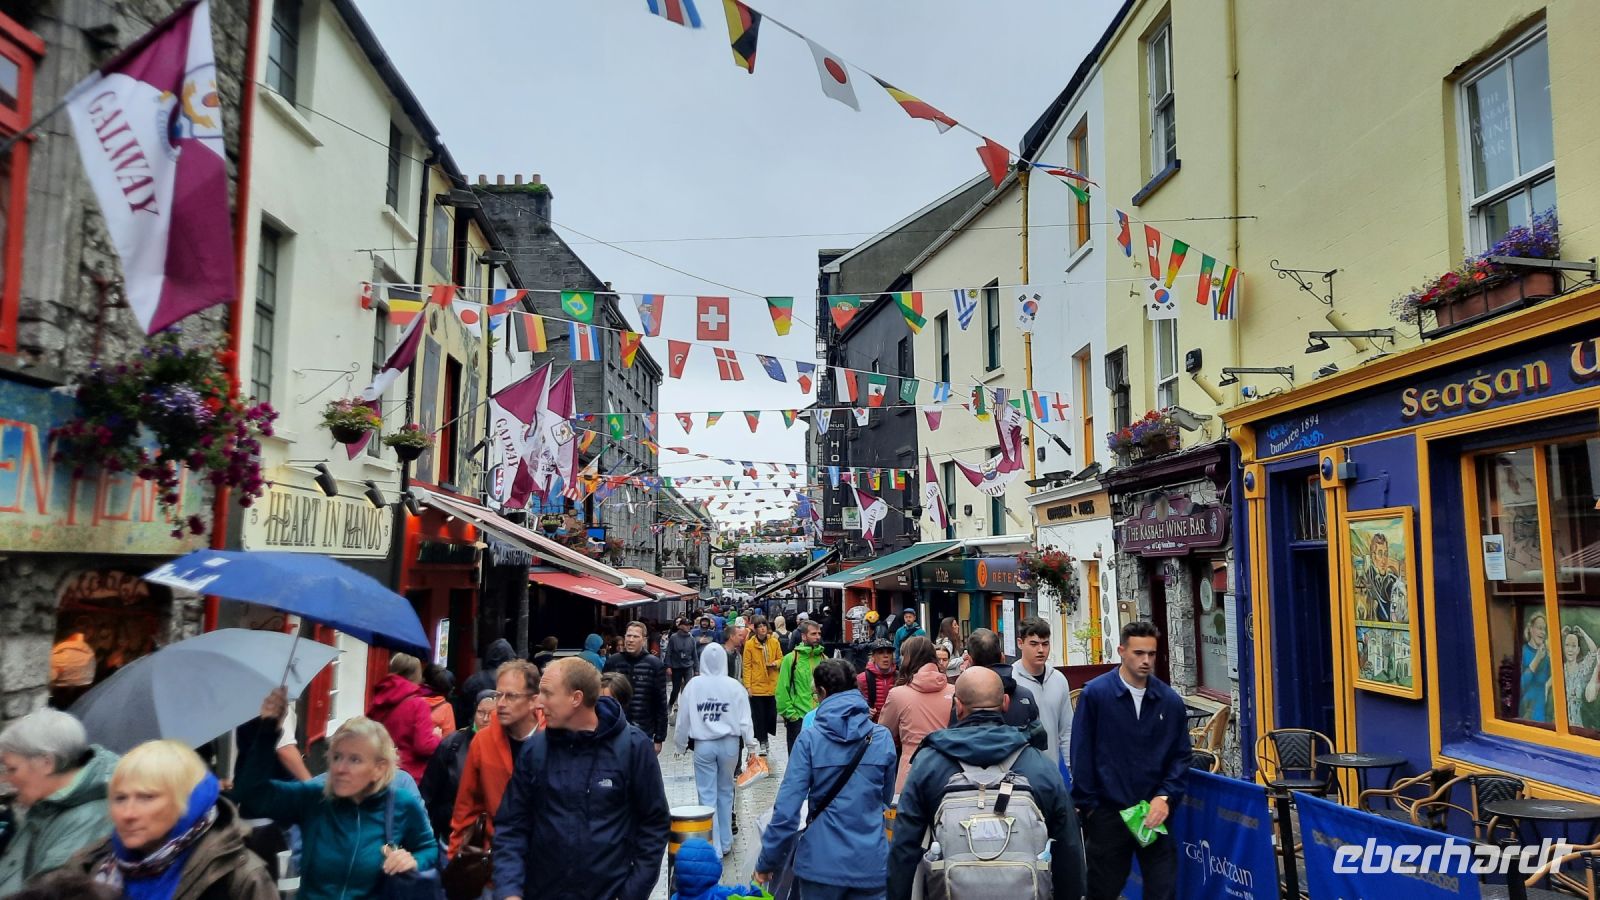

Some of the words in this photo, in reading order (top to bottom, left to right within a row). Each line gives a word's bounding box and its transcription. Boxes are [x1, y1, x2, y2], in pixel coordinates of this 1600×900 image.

[86, 90, 160, 218] GALWAY
[1301, 413, 1320, 433] 1894
[831, 440, 840, 505] HOEL
[264, 491, 322, 547] HEART
[322, 499, 342, 548] IN
[342, 503, 384, 551] HANDS
[1128, 526, 1139, 542] THE
[1139, 524, 1165, 541] KASBAH
[1165, 519, 1188, 538] WINE
[1189, 517, 1207, 536] BAR
[696, 702, 730, 713] WHITE
[702, 713, 722, 723] FOX
